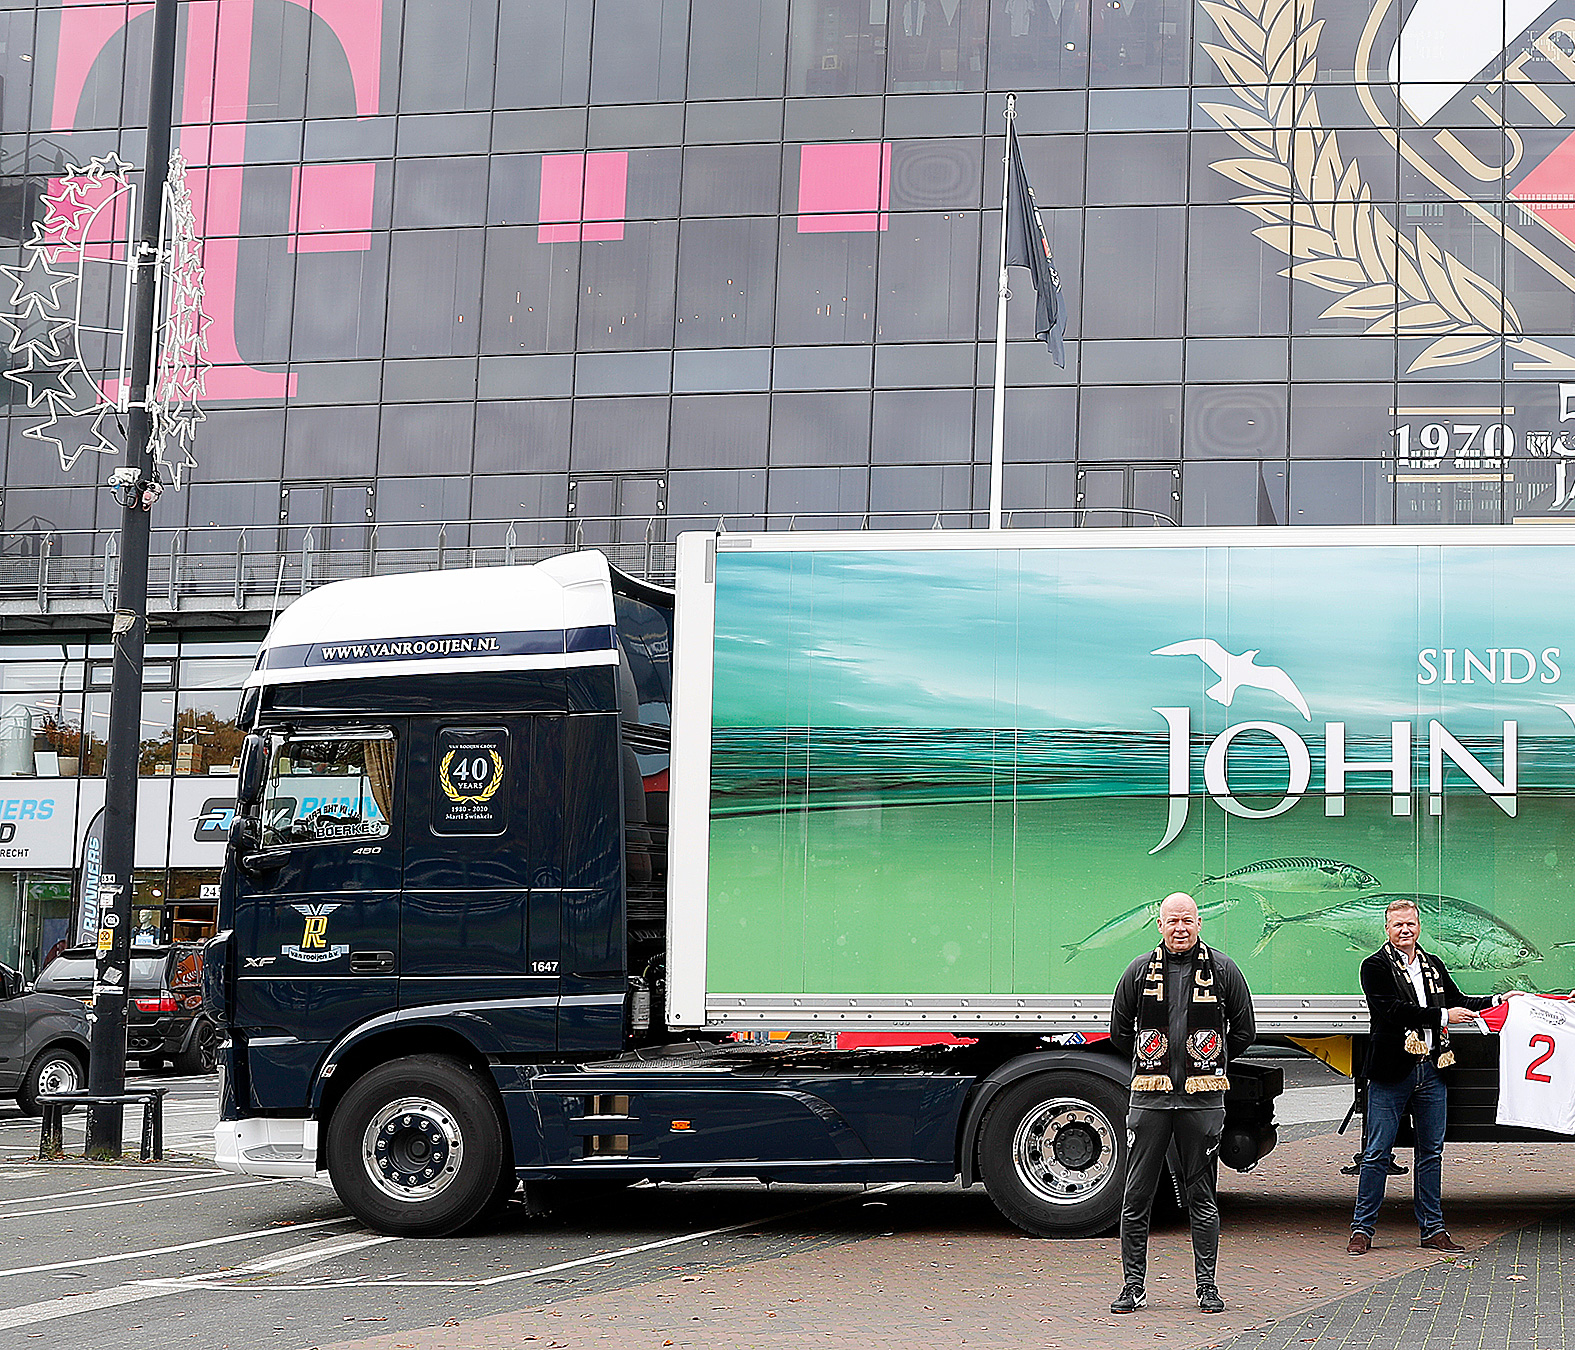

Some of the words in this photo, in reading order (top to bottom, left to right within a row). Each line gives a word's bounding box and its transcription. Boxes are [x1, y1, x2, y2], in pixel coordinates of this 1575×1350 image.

[1389, 423, 1516, 469] 1970
[321, 637, 500, 660] WWW.VANROOIJEN.NL
[1416, 647, 1561, 686] SINDS
[452, 757, 488, 781] 40
[1151, 706, 1519, 854] JOHN
[457, 782, 483, 790] YEARS
[83, 836, 101, 932] RUNNERS
[243, 956, 277, 968] XF
[531, 961, 559, 972] 1647
[1525, 1034, 1555, 1083] 2
